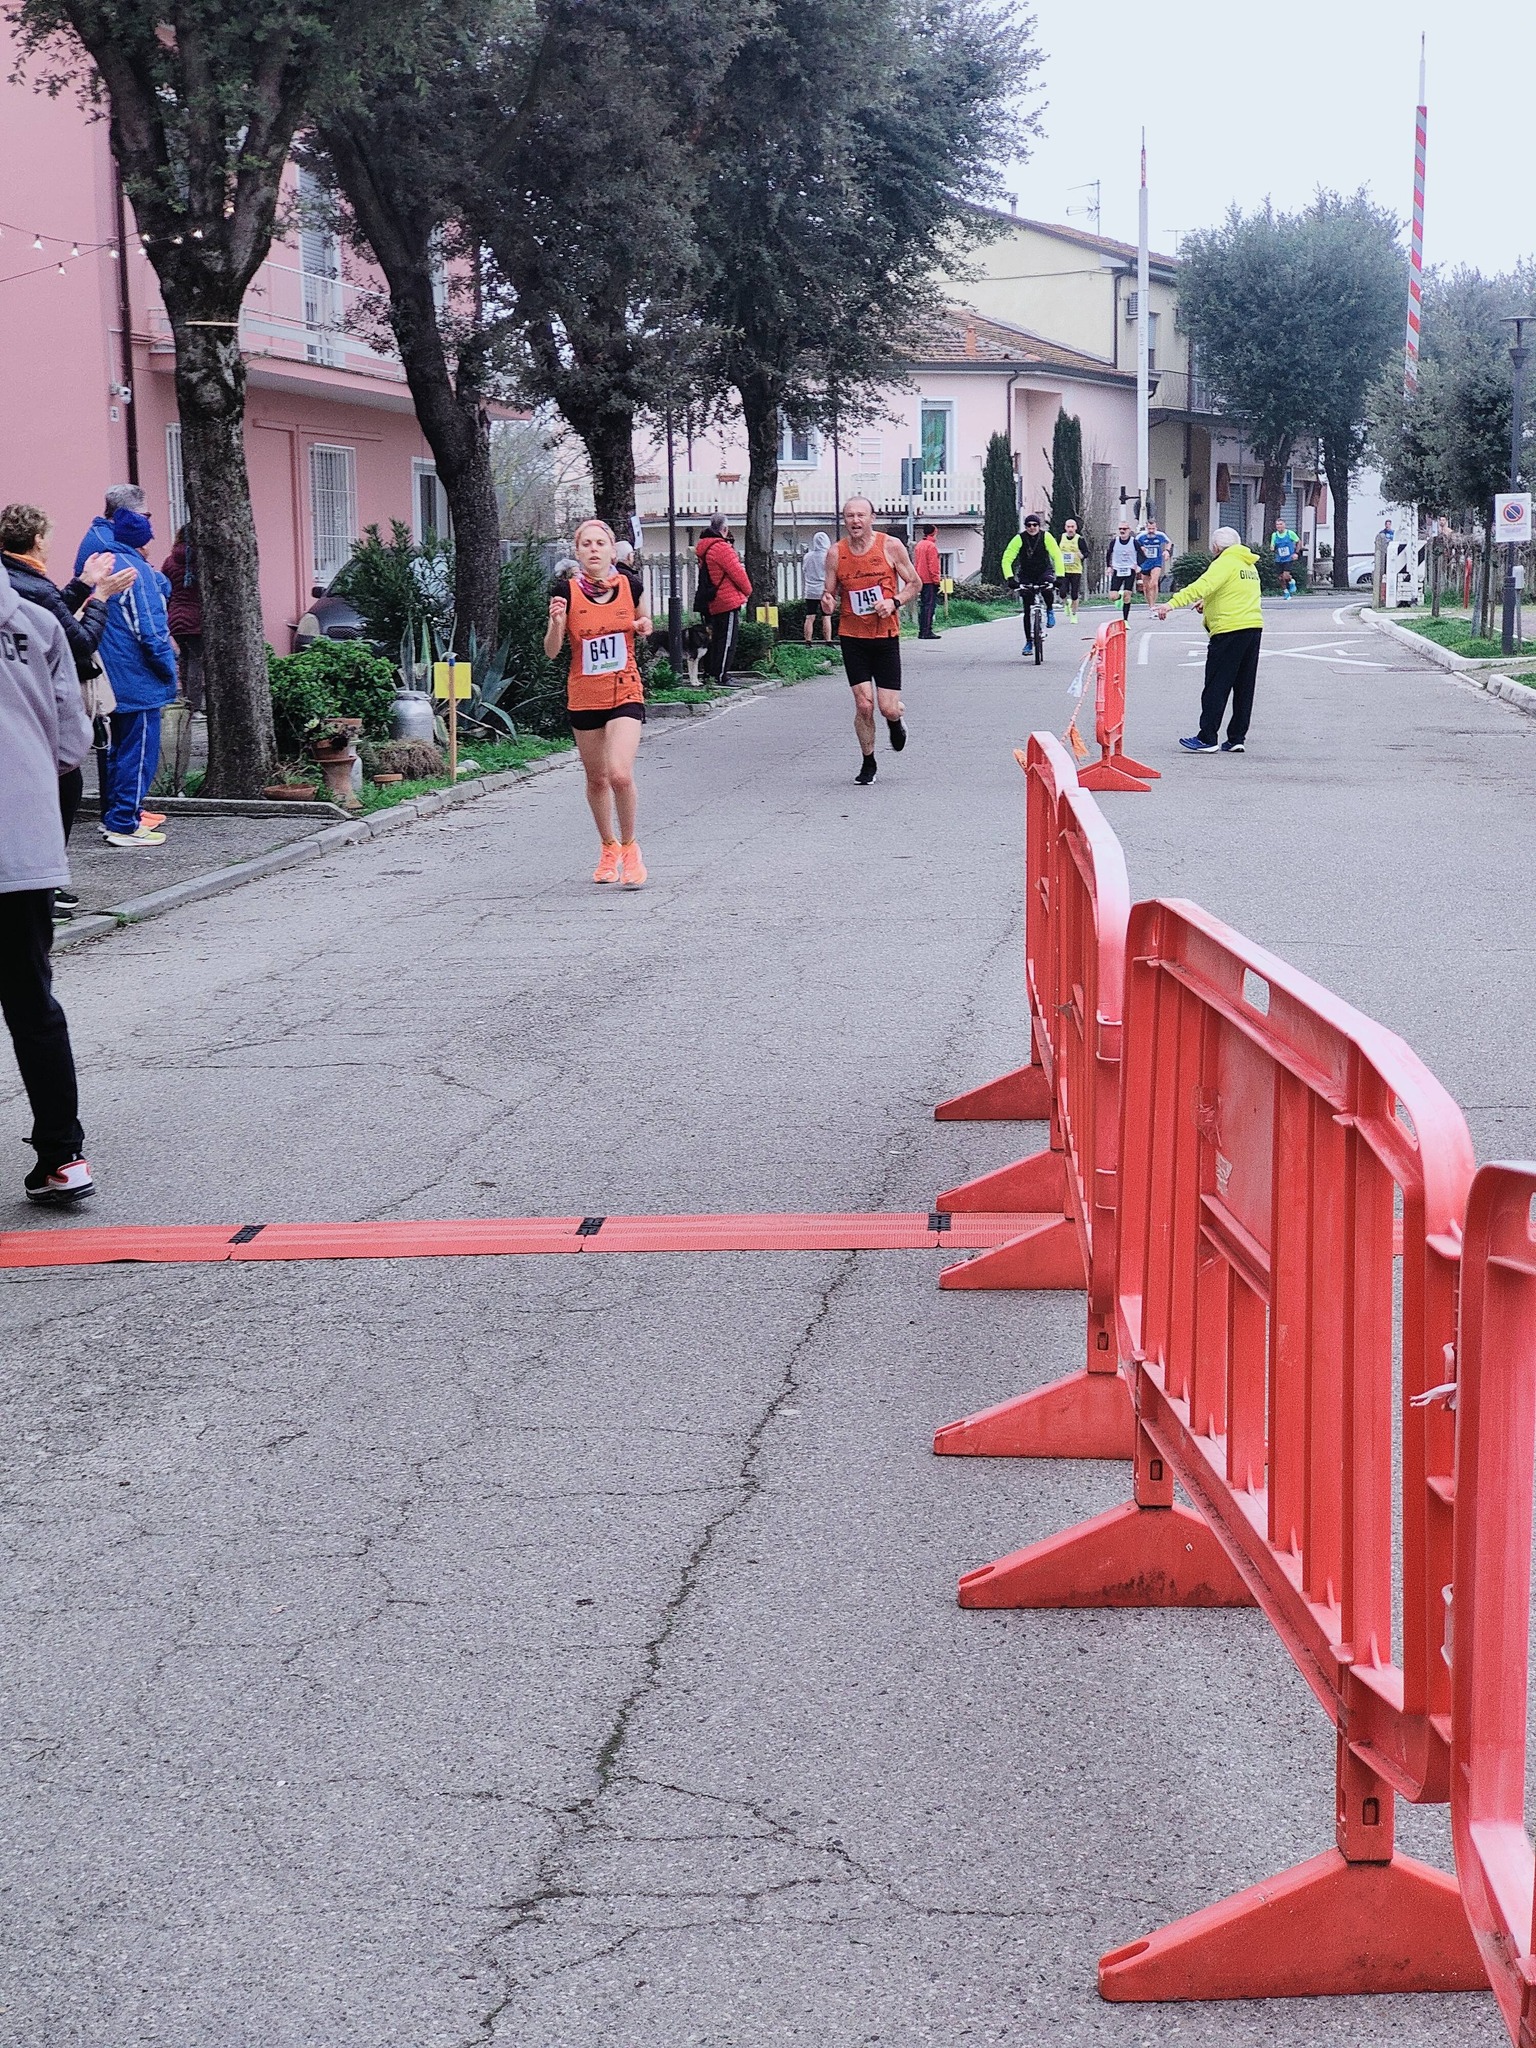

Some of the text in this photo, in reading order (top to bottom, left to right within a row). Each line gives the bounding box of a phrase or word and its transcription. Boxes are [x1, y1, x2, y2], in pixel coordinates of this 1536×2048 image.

[855, 588, 878, 607] 745
[0, 631, 28, 665] CE
[590, 636, 616, 662] 647
